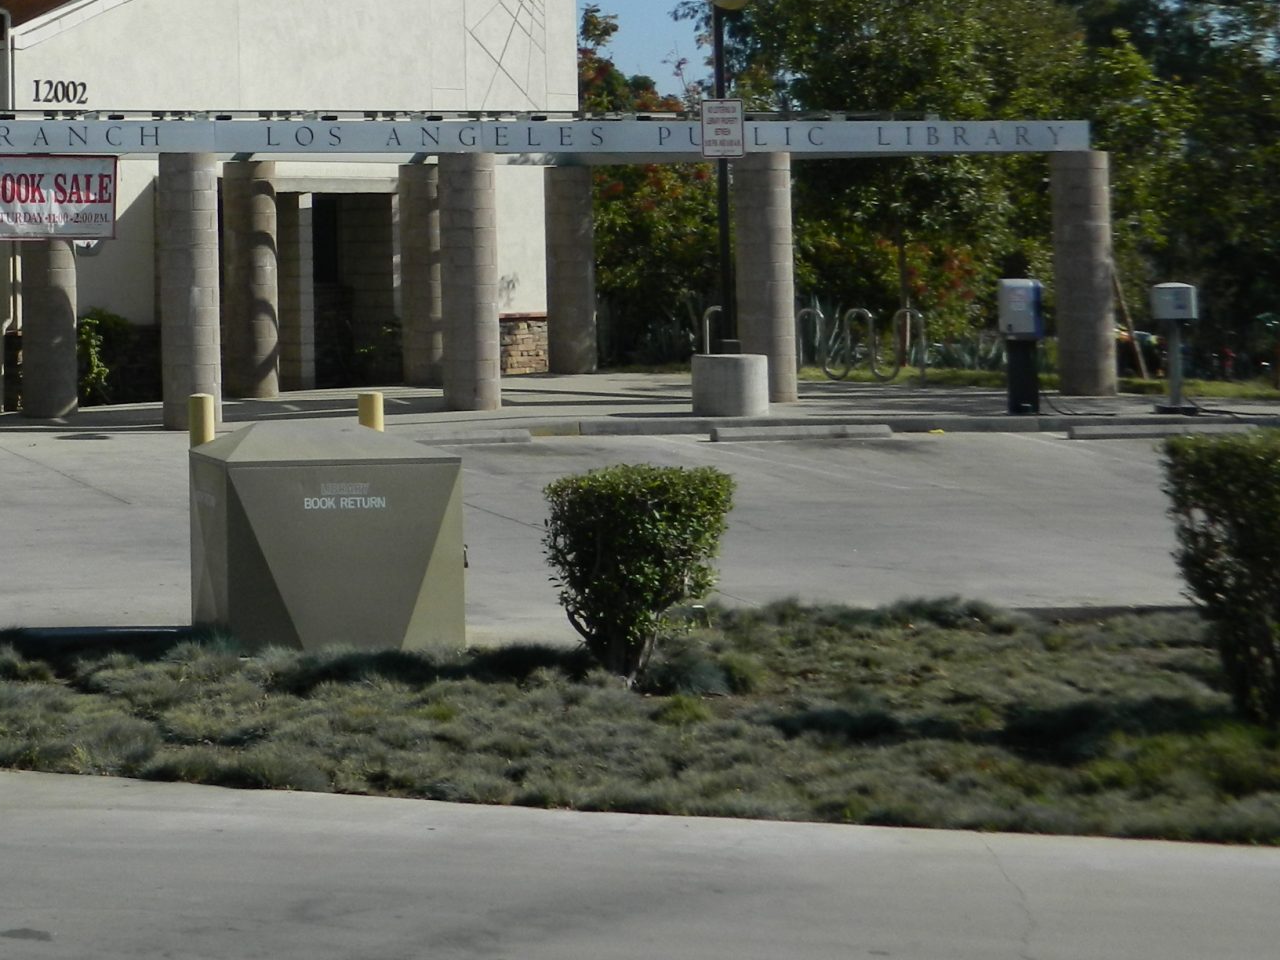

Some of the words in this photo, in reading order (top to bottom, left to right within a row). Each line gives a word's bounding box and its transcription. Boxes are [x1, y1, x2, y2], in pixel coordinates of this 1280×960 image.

[32, 79, 89, 105] 12002
[266, 125, 343, 147] LOS
[386, 125, 604, 147] ANGELES
[658, 126, 825, 146] PULIC
[877, 126, 1065, 146] LIBRARY
[54, 173, 112, 204] SALE
[304, 497, 337, 509] BOOK
[340, 496, 386, 509] RETURN
